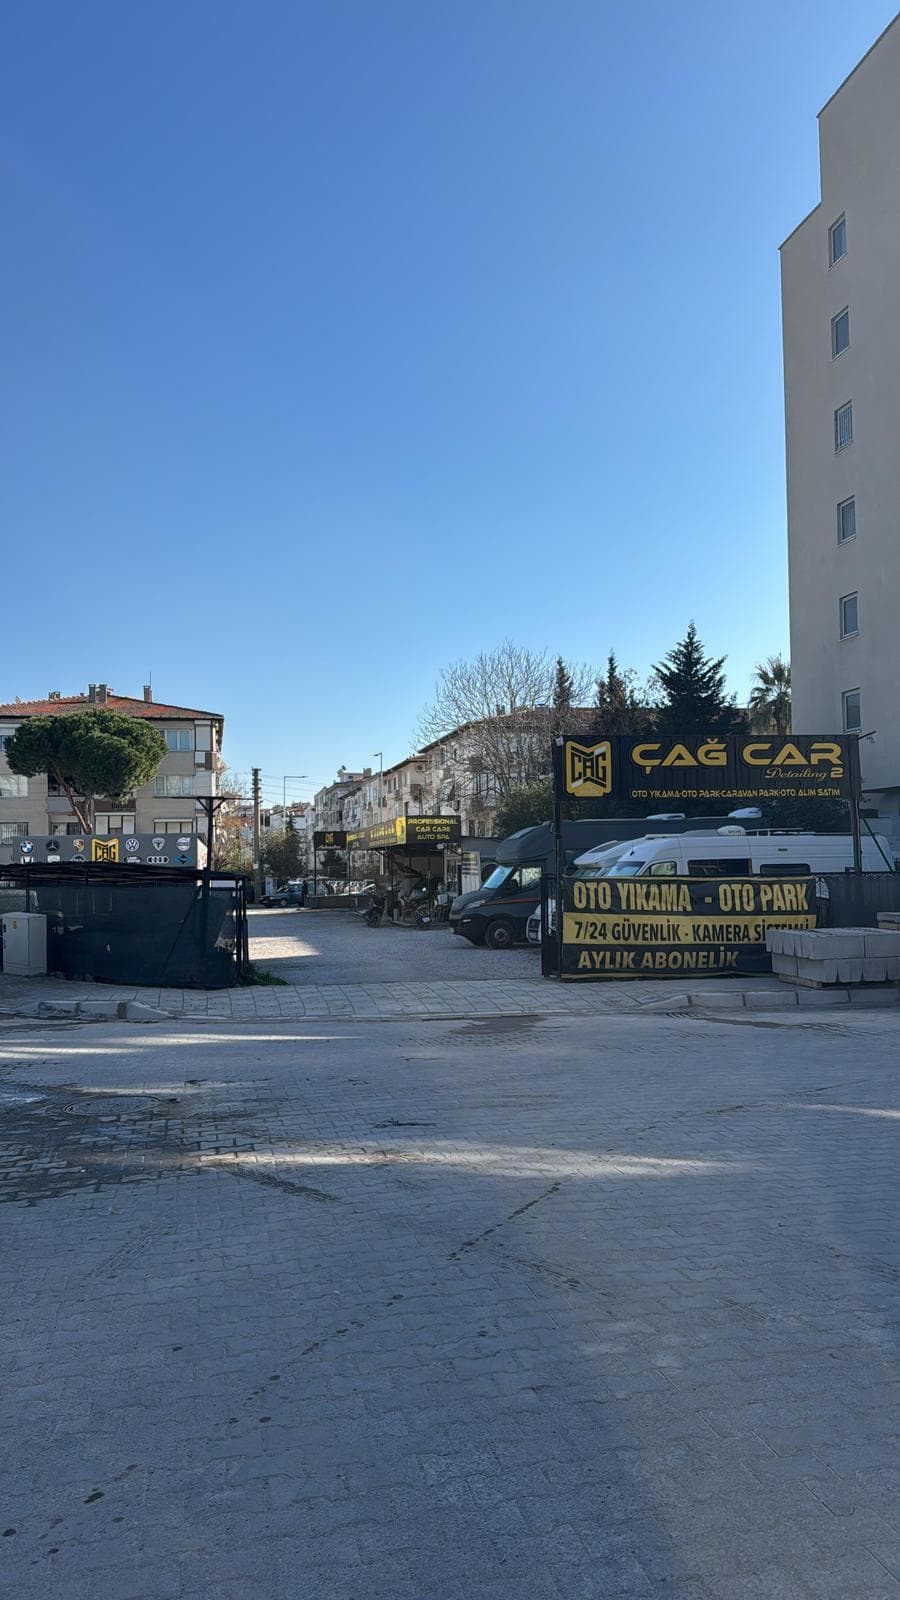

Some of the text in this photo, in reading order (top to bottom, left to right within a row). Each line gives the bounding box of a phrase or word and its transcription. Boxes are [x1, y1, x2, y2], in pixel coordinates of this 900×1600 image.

[631, 738, 843, 775] ÇAĞ CAR
[764, 767, 844, 781] Detailing 2
[631, 790, 648, 798] OTO
[798, 788, 817, 796] ALIM
[817, 788, 841, 796] SATIM
[573, 881, 612, 910] OTO
[617, 883, 692, 912] YIKAMA
[718, 883, 754, 912] OTO
[760, 882, 809, 912] PARK
[574, 920, 607, 940] 7/24
[611, 918, 681, 942] GÜVENLİK
[692, 923, 751, 942] KAMERA
[577, 946, 740, 969] AYLIK ABONELİK
